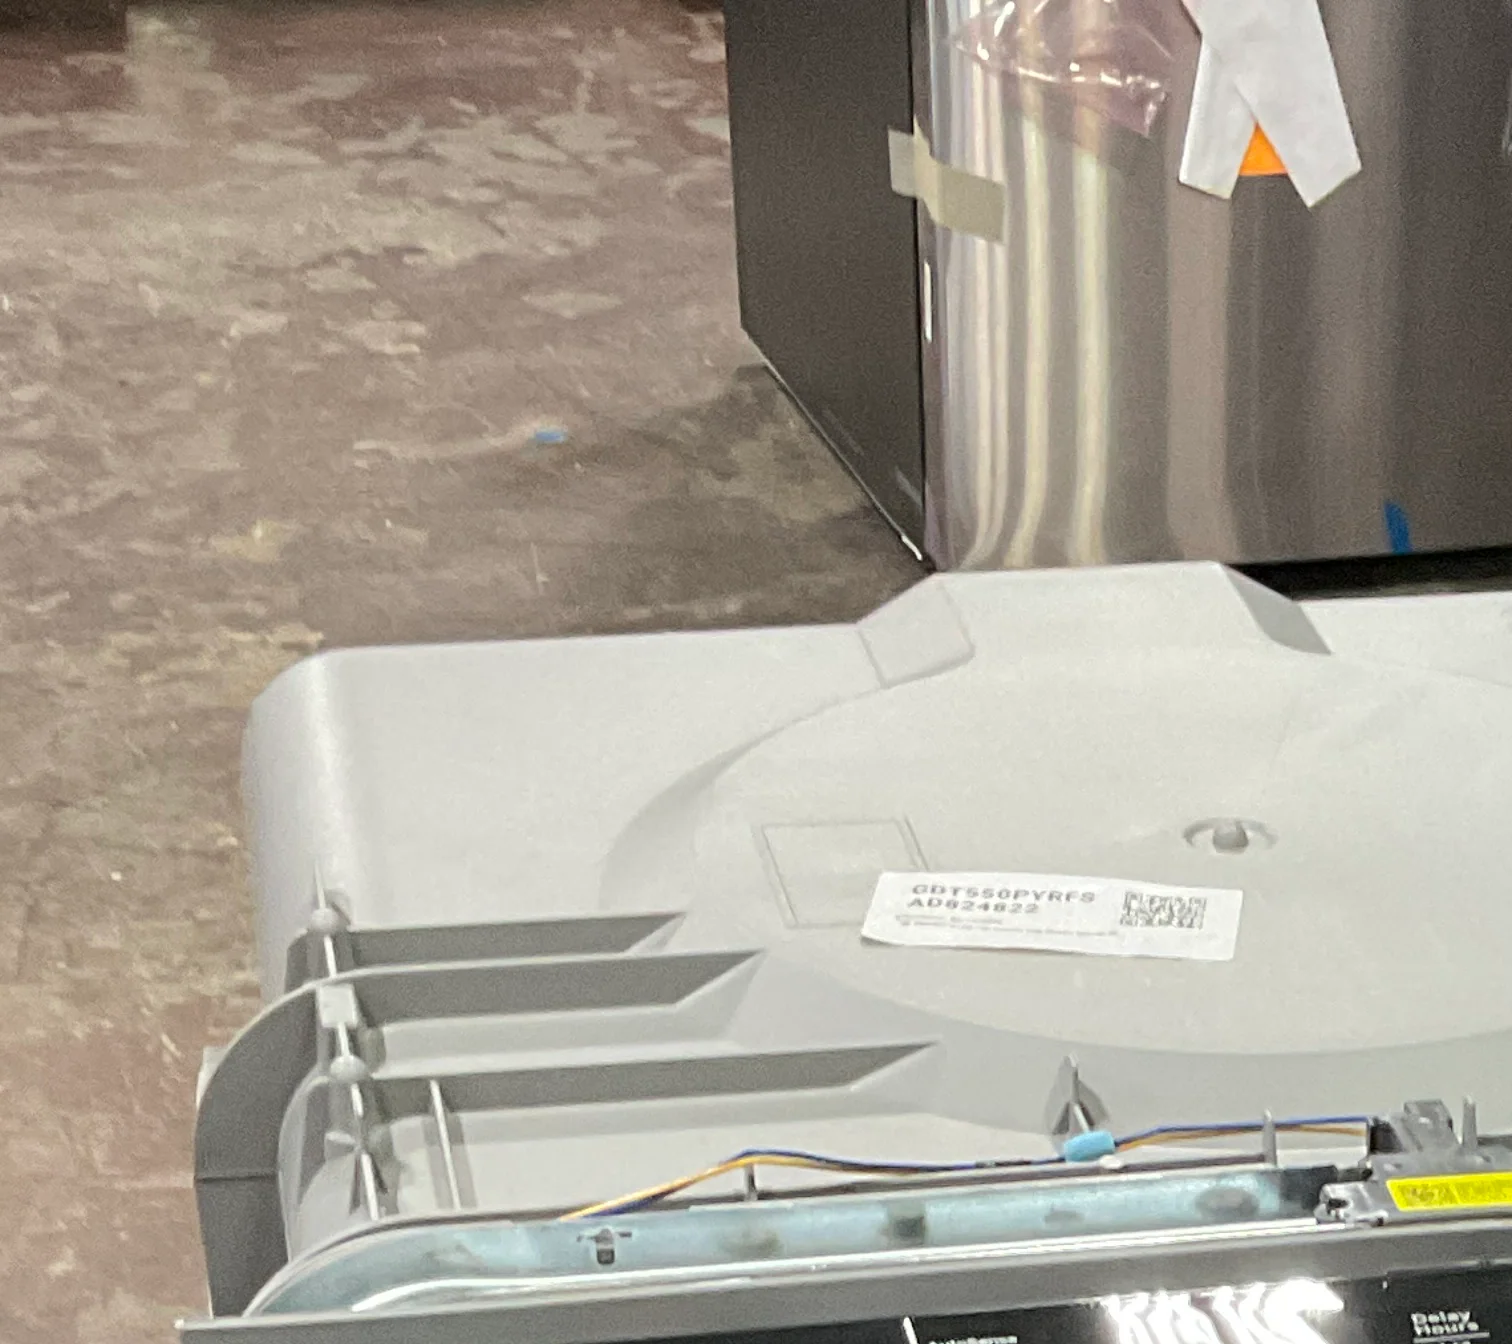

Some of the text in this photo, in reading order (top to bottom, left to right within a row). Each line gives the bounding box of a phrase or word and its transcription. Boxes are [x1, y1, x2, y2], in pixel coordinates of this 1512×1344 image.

[912, 884, 1097, 903] GDT550PYRFS
[1411, 1310, 1471, 1327] Delay
[1413, 1321, 1480, 1336] Hours
